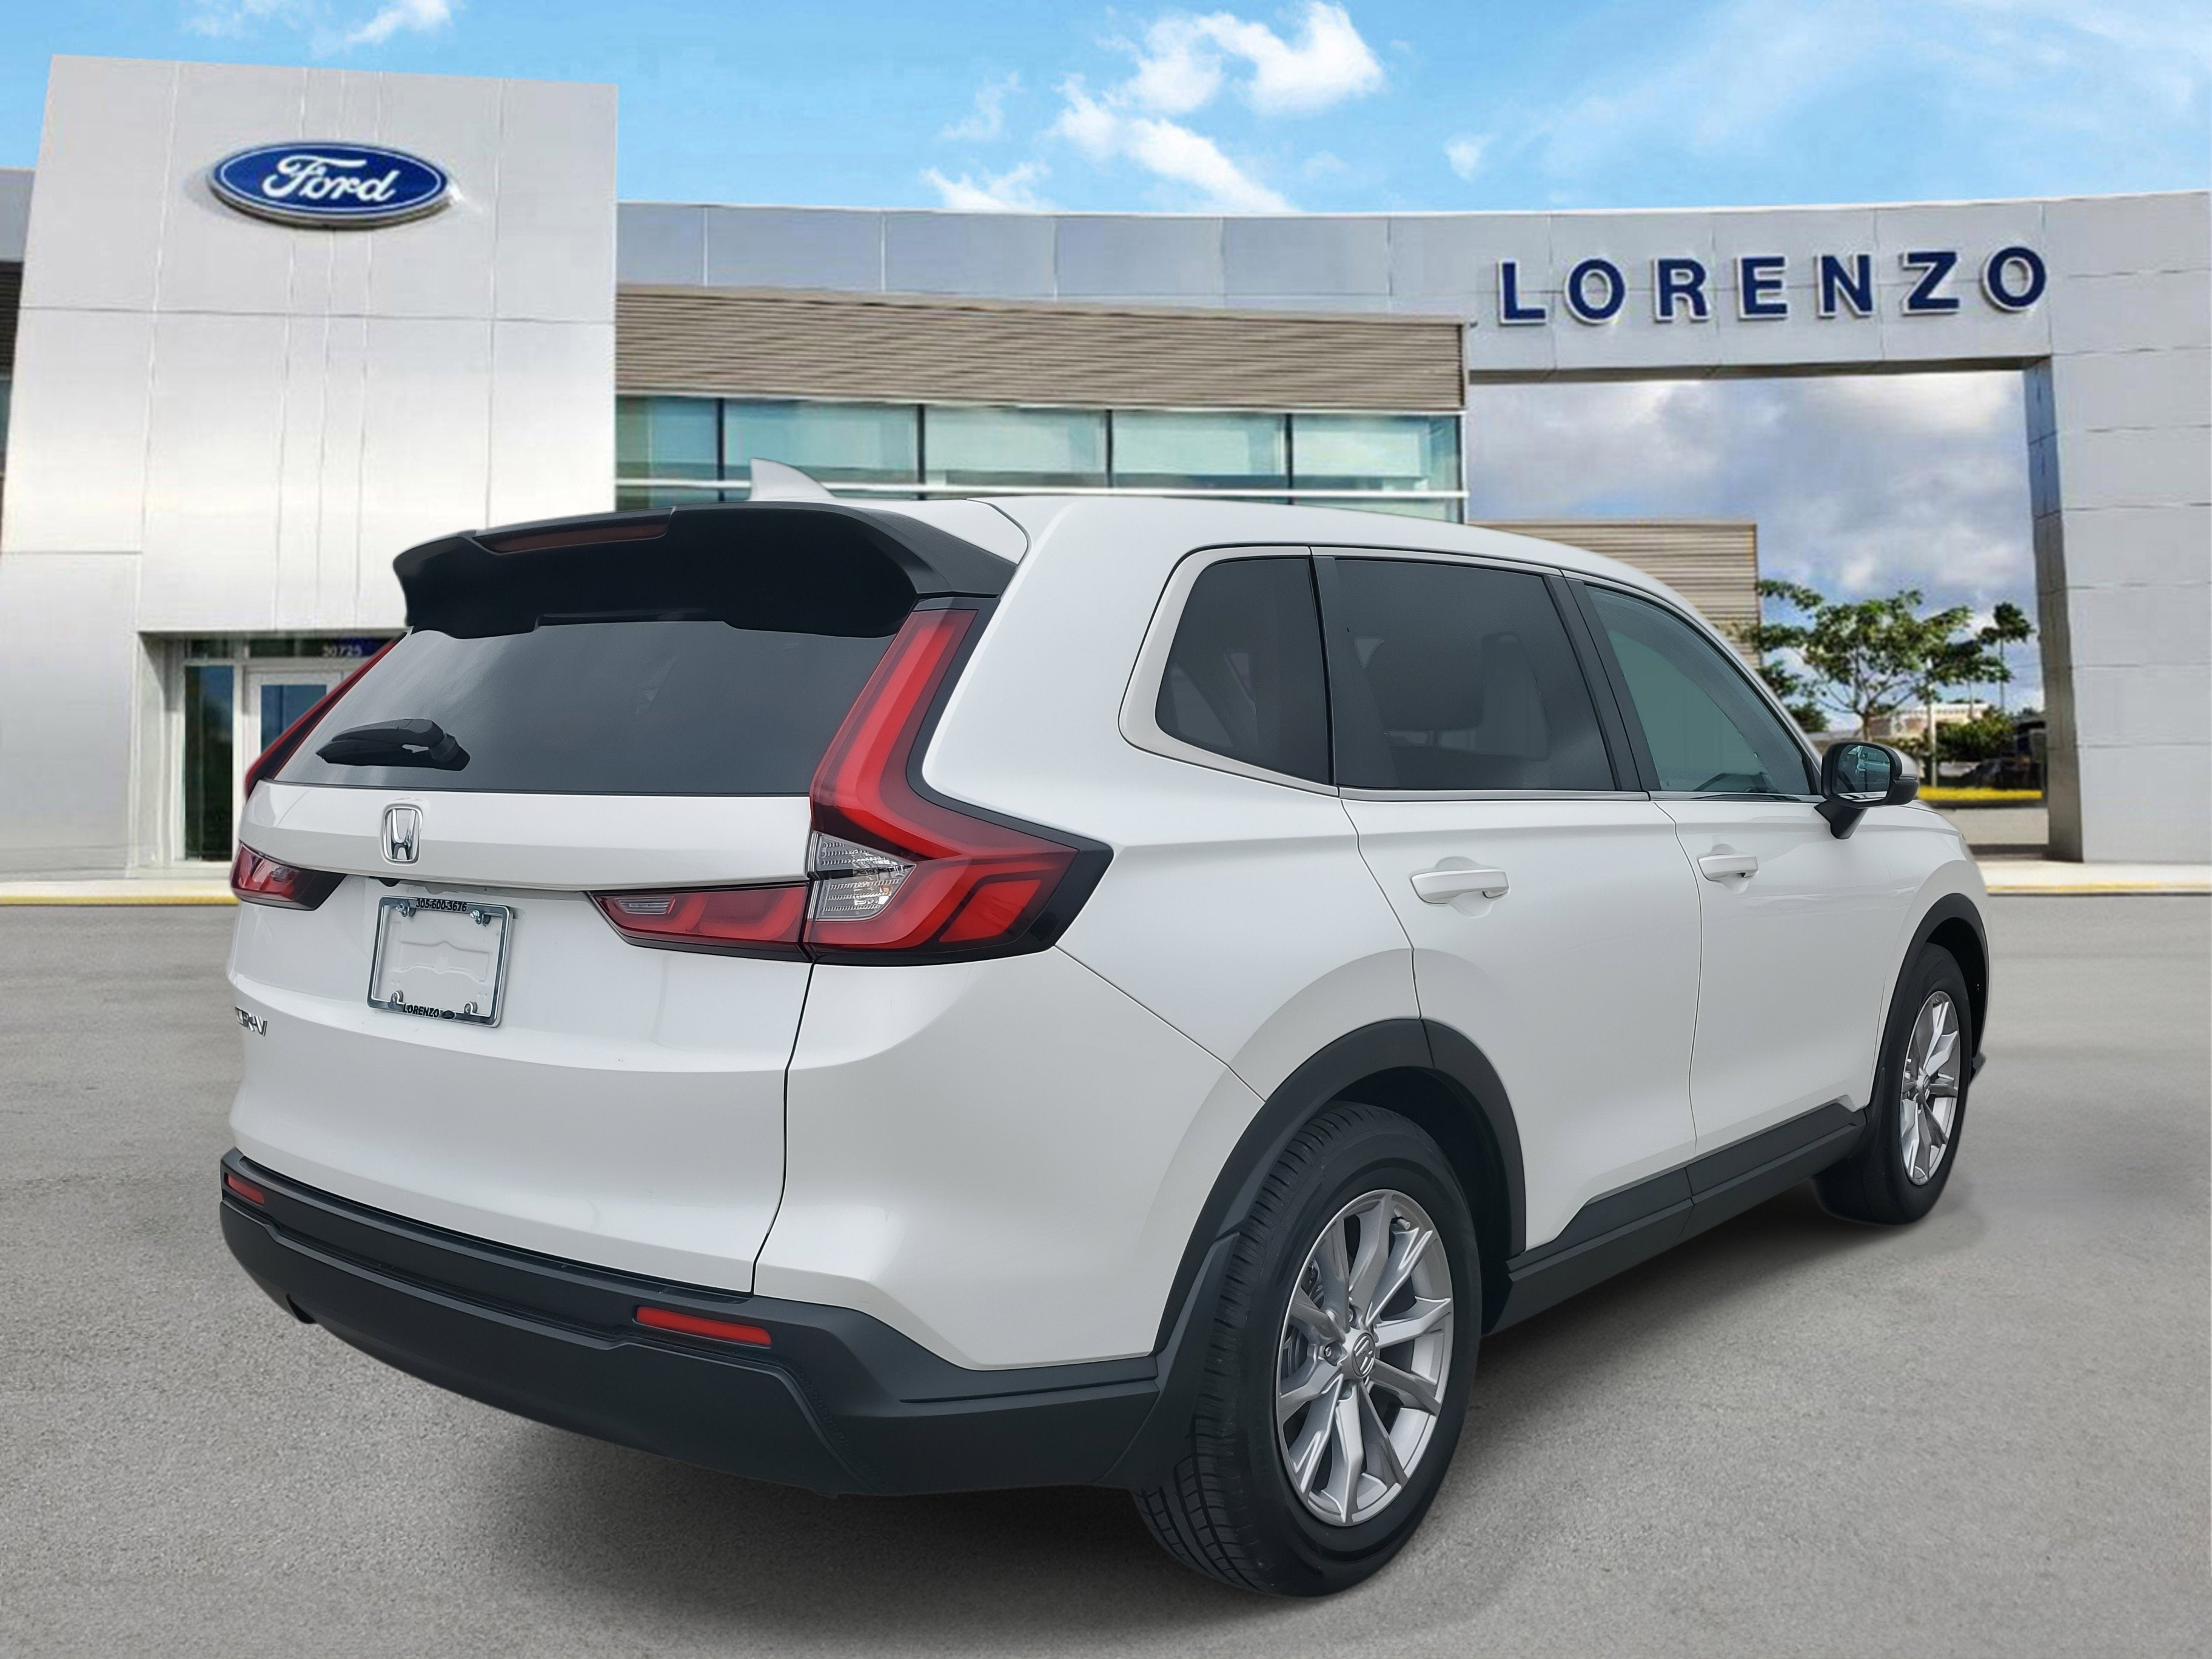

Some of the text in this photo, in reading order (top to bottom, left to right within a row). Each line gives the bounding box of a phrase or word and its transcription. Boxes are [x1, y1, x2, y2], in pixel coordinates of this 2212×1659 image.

[262, 155, 400, 202] Ford
[1498, 246, 2047, 324] LORENZO
[403, 1003, 440, 1018] LORENZO
